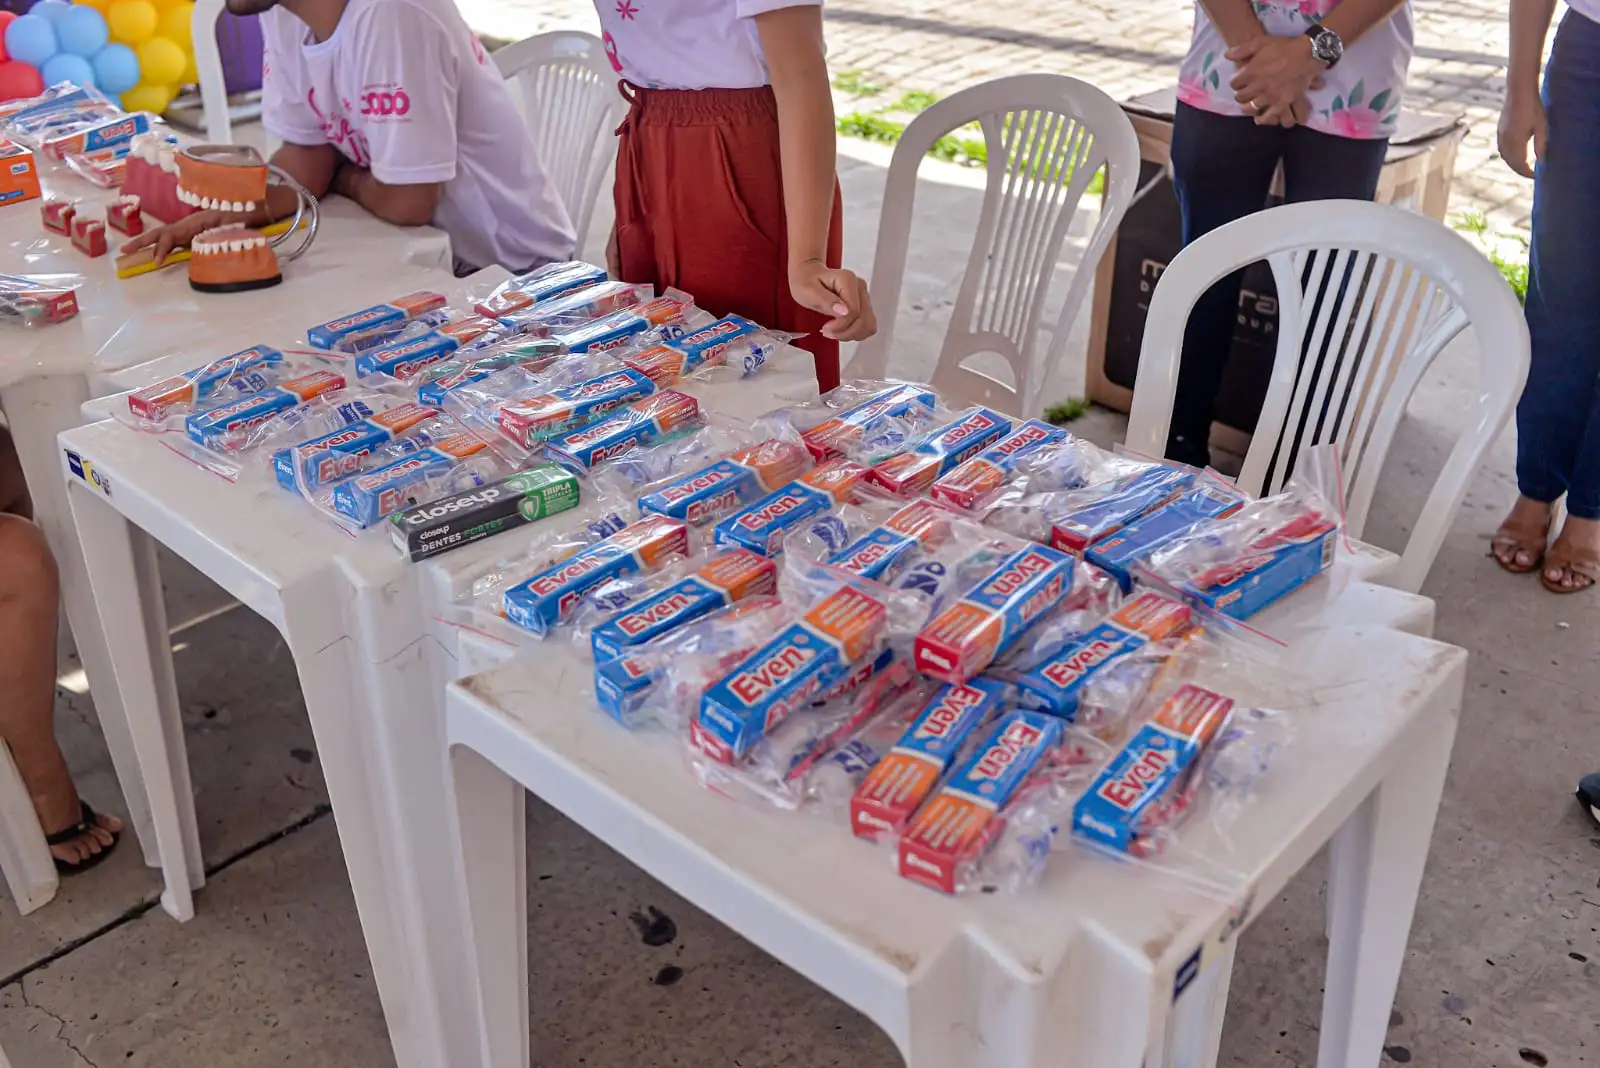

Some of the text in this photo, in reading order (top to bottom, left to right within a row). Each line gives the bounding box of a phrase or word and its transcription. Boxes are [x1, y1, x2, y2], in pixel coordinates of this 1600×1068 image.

[302, 431, 360, 458] Even
[503, 420, 520, 436] Even
[943, 415, 994, 445] Even
[999, 426, 1049, 454] Even
[320, 450, 370, 482] Even
[359, 460, 421, 489] Even
[544, 482, 571, 497] TRIPLA
[661, 471, 724, 502] Even
[407, 489, 500, 524] closeup
[738, 496, 800, 530] Even
[421, 533, 461, 552] DENTES
[836, 545, 889, 572] ven
[530, 556, 600, 596] Even
[993, 552, 1053, 595] Even
[617, 594, 689, 635] Even
[730, 646, 804, 704] Even
[1044, 640, 1109, 686] Even
[923, 684, 983, 735] Even
[977, 722, 1041, 779] Even
[1101, 750, 1169, 808] Even
